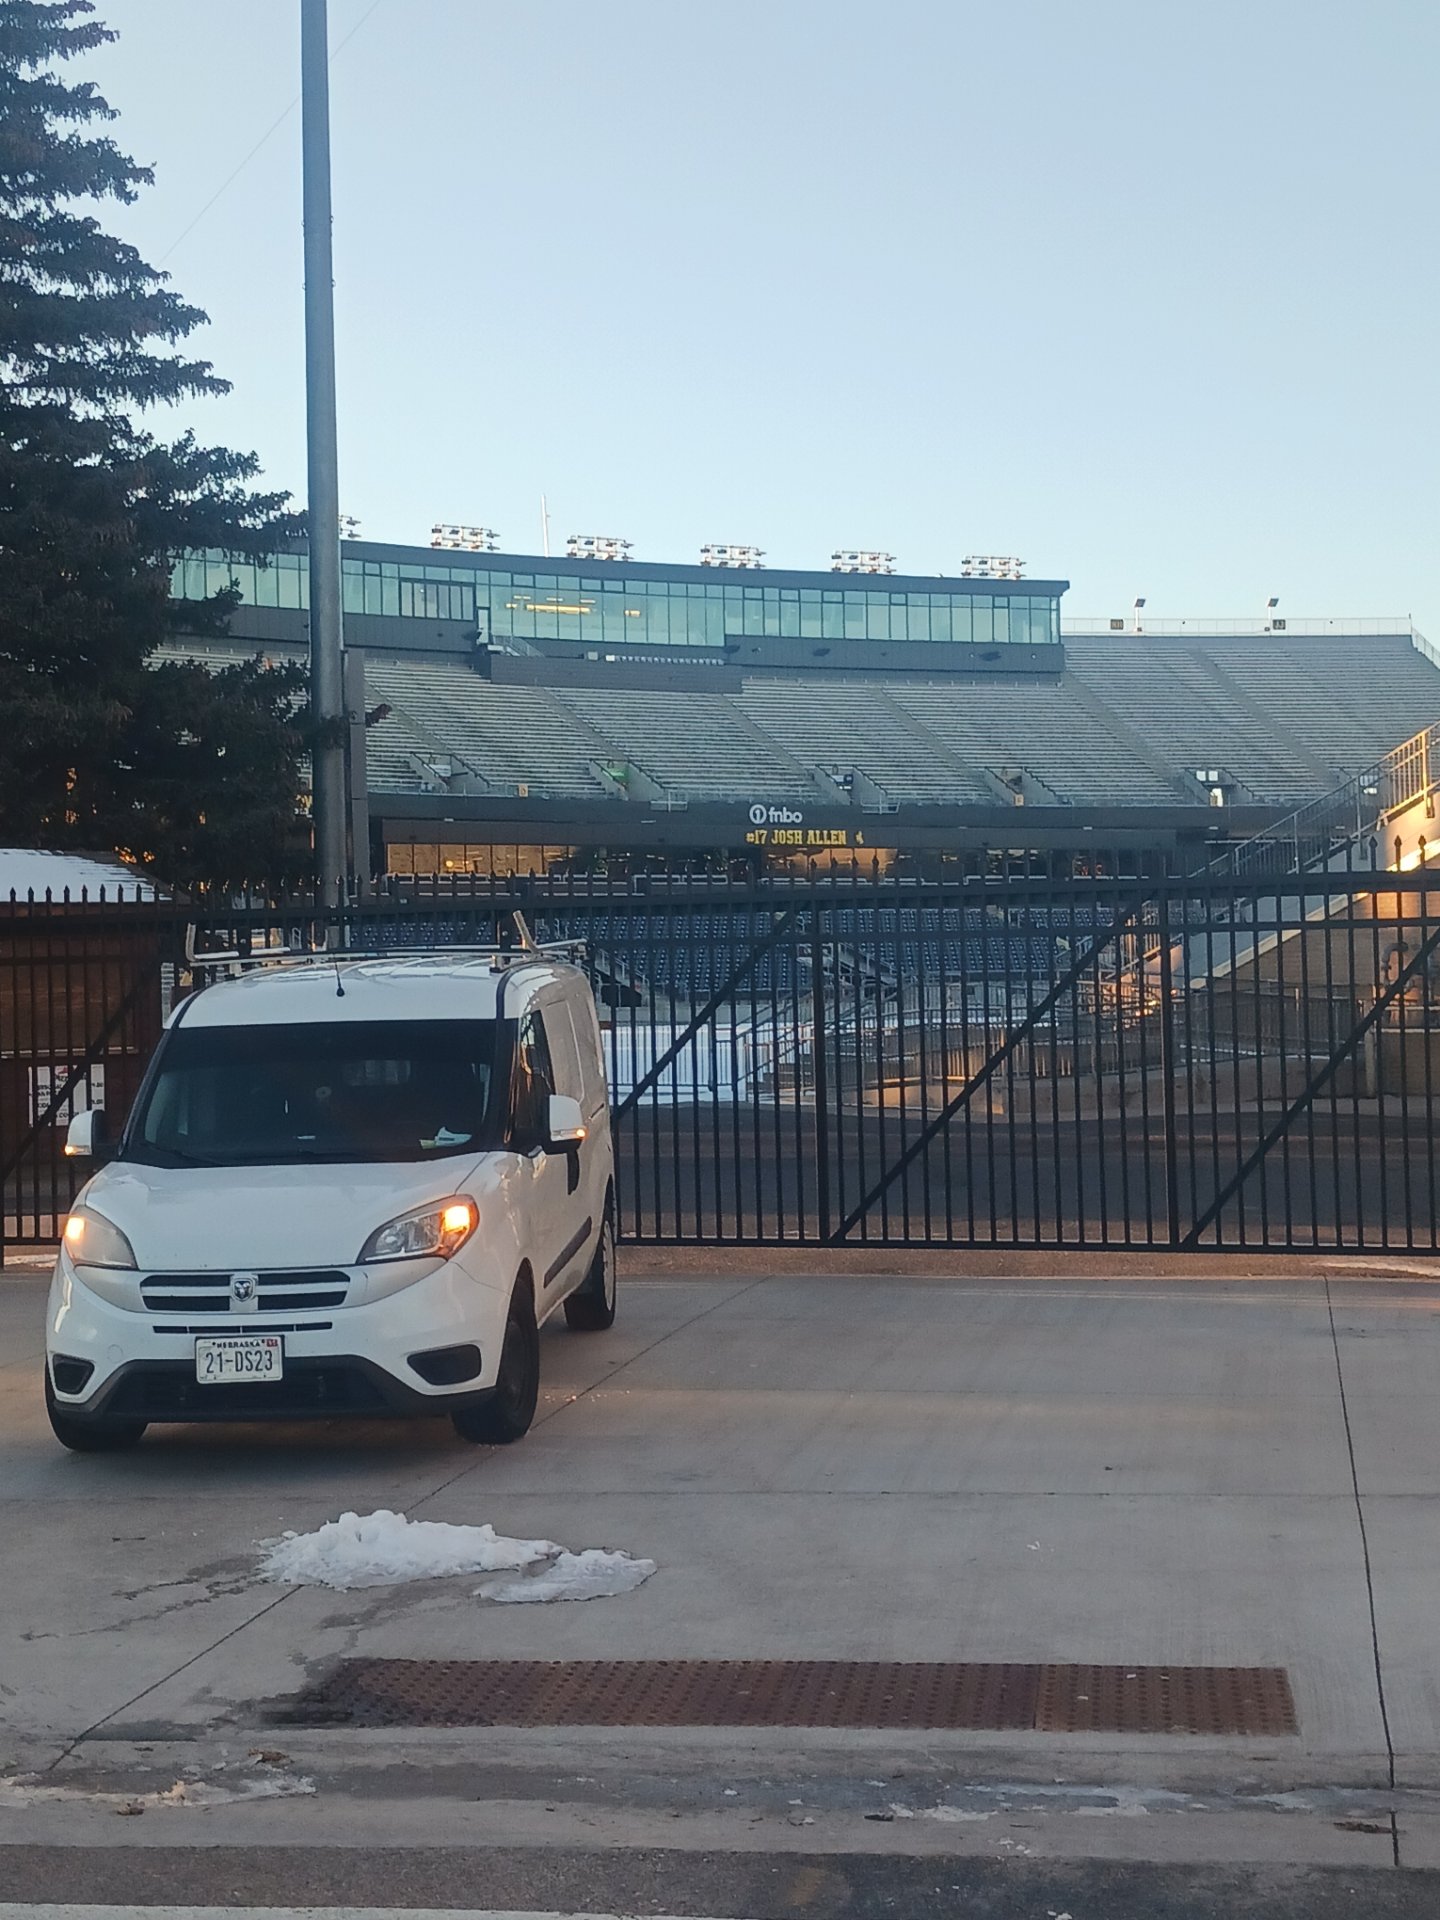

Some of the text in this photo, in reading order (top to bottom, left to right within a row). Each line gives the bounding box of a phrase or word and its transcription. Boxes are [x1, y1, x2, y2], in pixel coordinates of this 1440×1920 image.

[768, 806, 803, 824] fnbo
[771, 830, 803, 845] JOSH
[807, 830, 847, 845] ALLEN
[205, 1350, 273, 1374] 21-DS23
